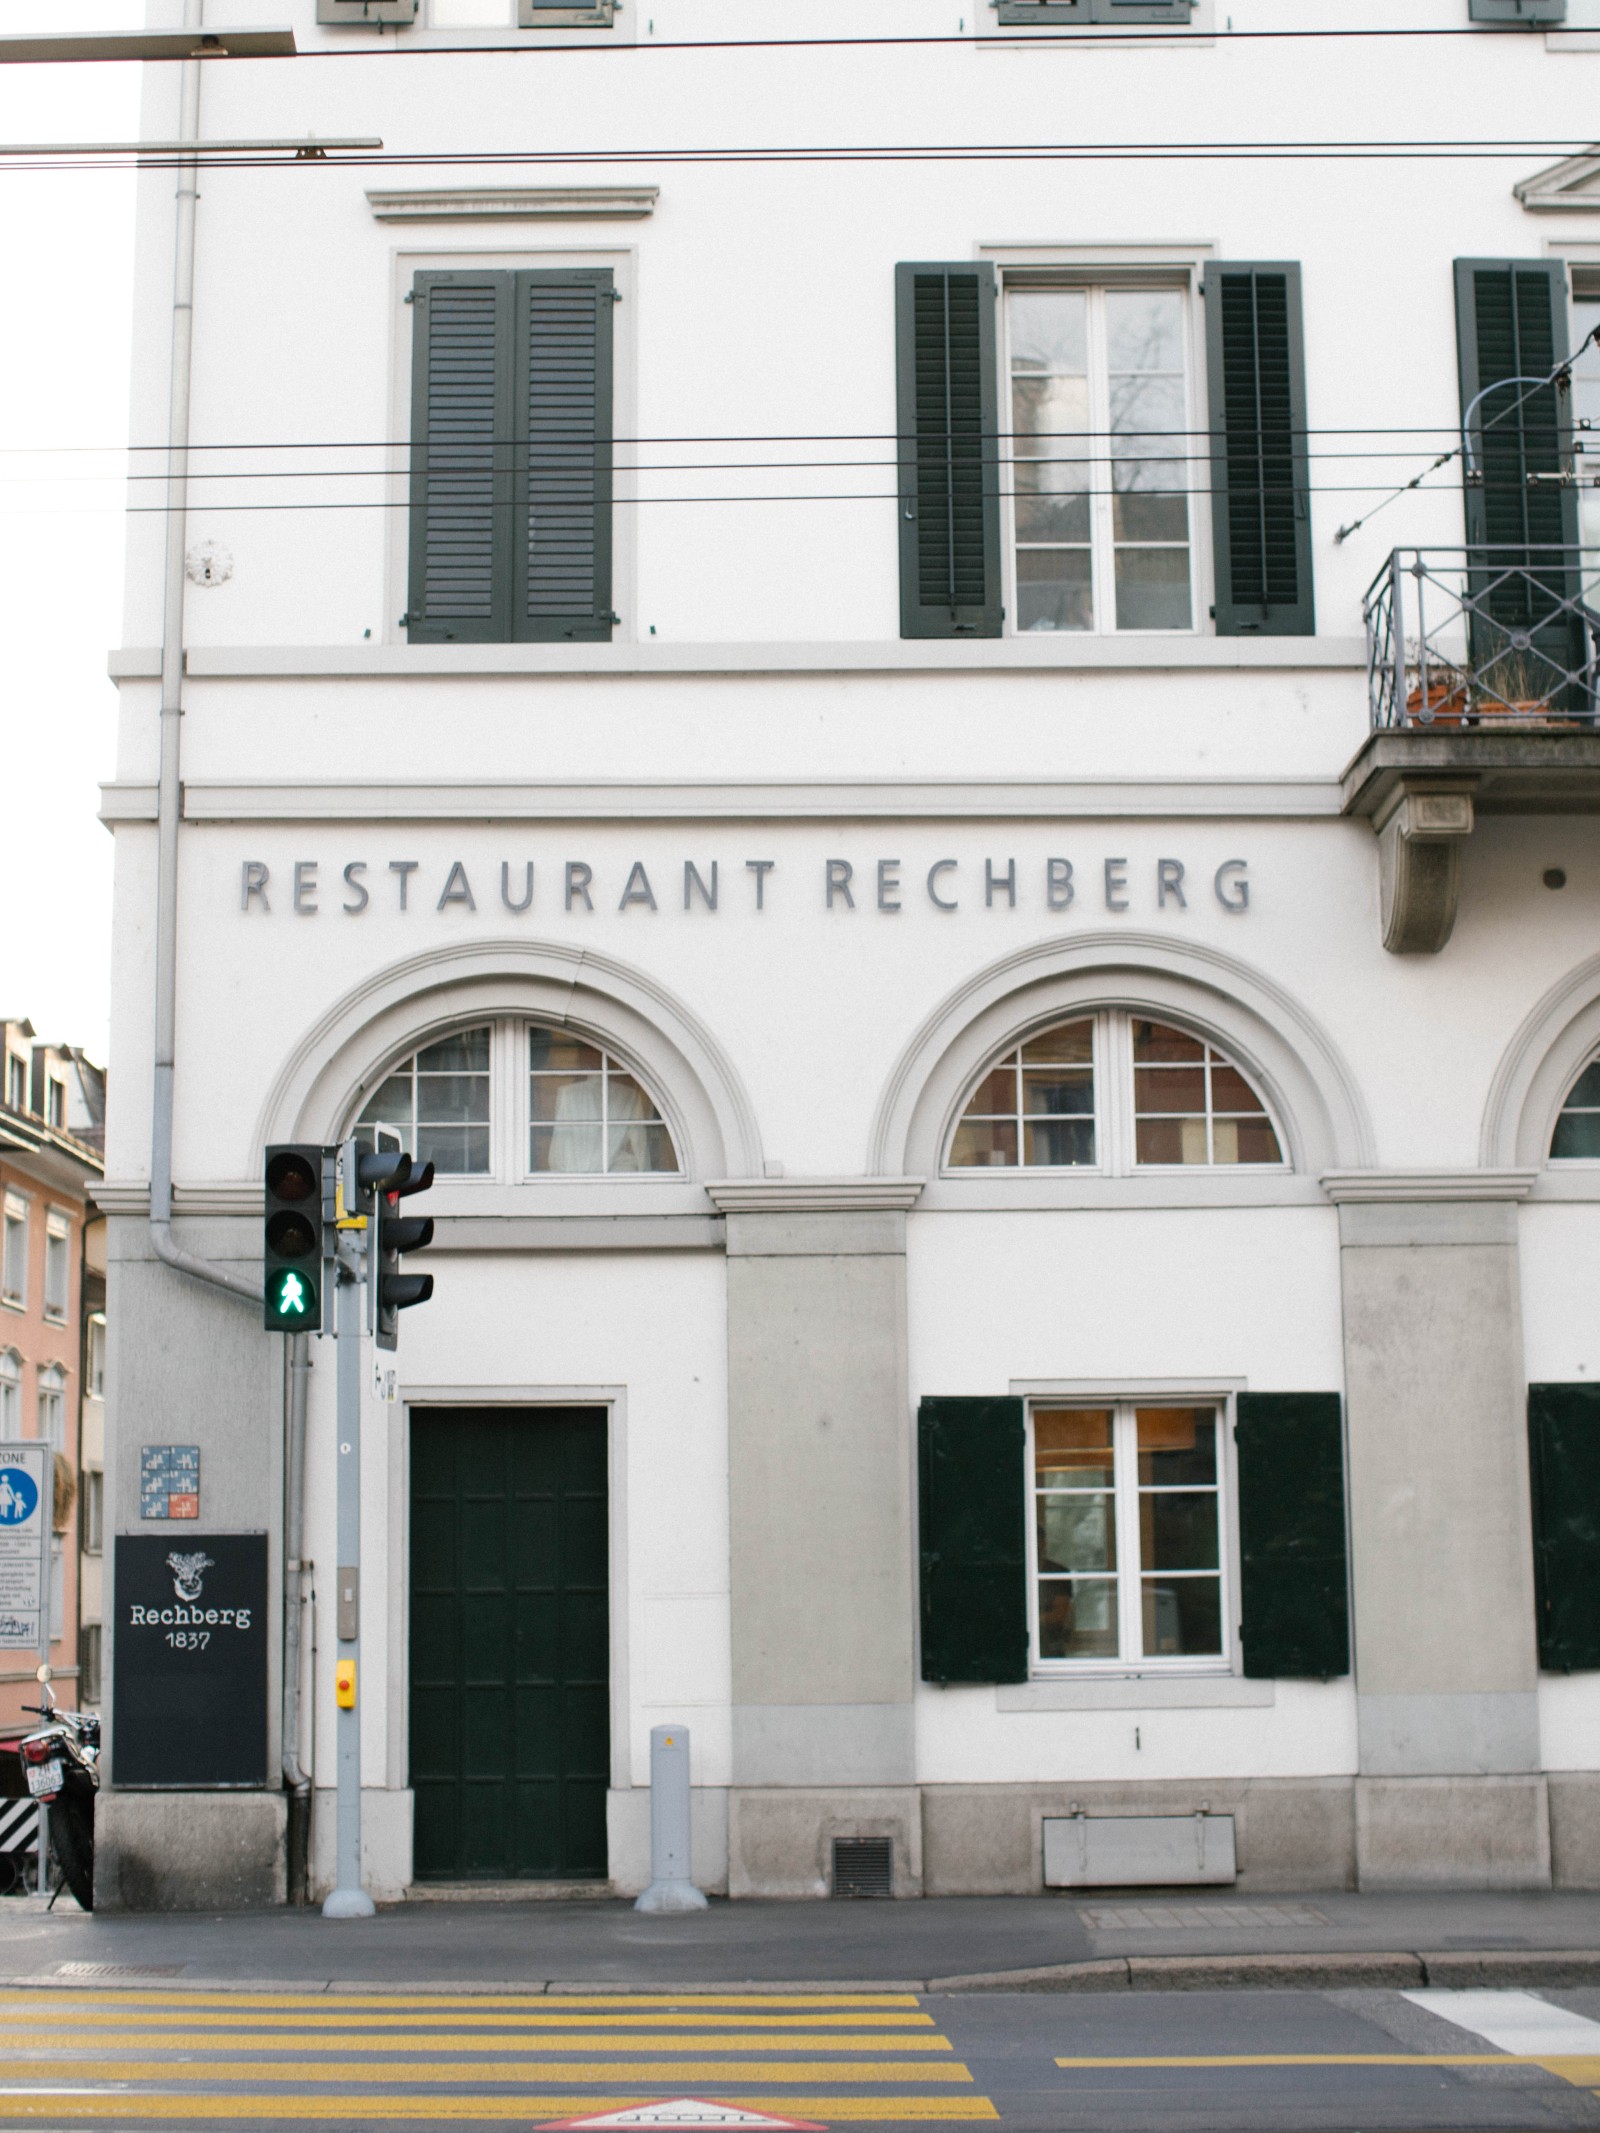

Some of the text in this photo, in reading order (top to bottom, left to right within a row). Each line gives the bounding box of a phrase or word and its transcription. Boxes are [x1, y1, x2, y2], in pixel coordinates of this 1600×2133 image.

[241, 857, 1251, 914] RESTAURANT RECHBERG
[0, 1452, 26, 1464] ONE
[130, 1604, 251, 1629] Rechberg
[165, 1631, 210, 1650] 1837
